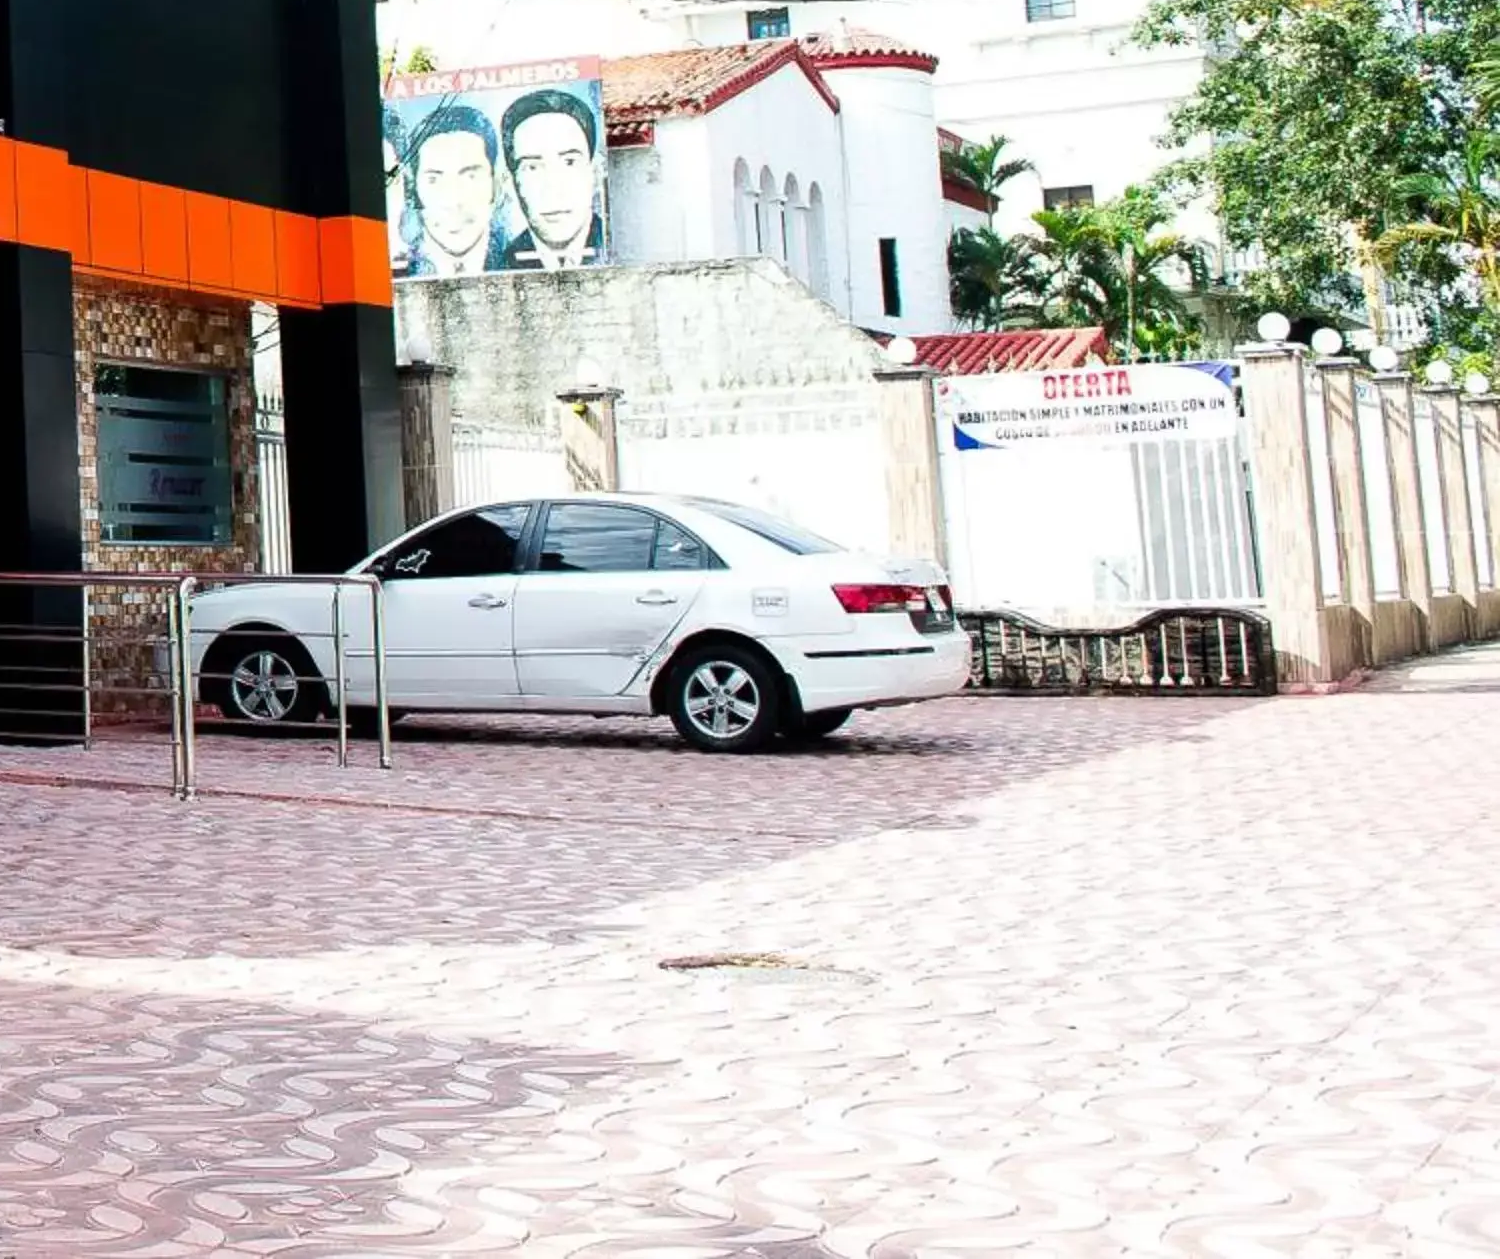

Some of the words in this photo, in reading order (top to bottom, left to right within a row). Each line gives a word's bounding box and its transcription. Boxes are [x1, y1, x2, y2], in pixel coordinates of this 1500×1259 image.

[392, 79, 408, 97] A
[414, 74, 454, 94] LOS
[459, 60, 580, 90] PALMEROS
[1043, 369, 1133, 400] OFERTA
[1029, 406, 1070, 421] SIMPLE
[1181, 397, 1206, 412] CON
[1209, 396, 1226, 410] UN
[1131, 416, 1189, 433] ADELANTE
